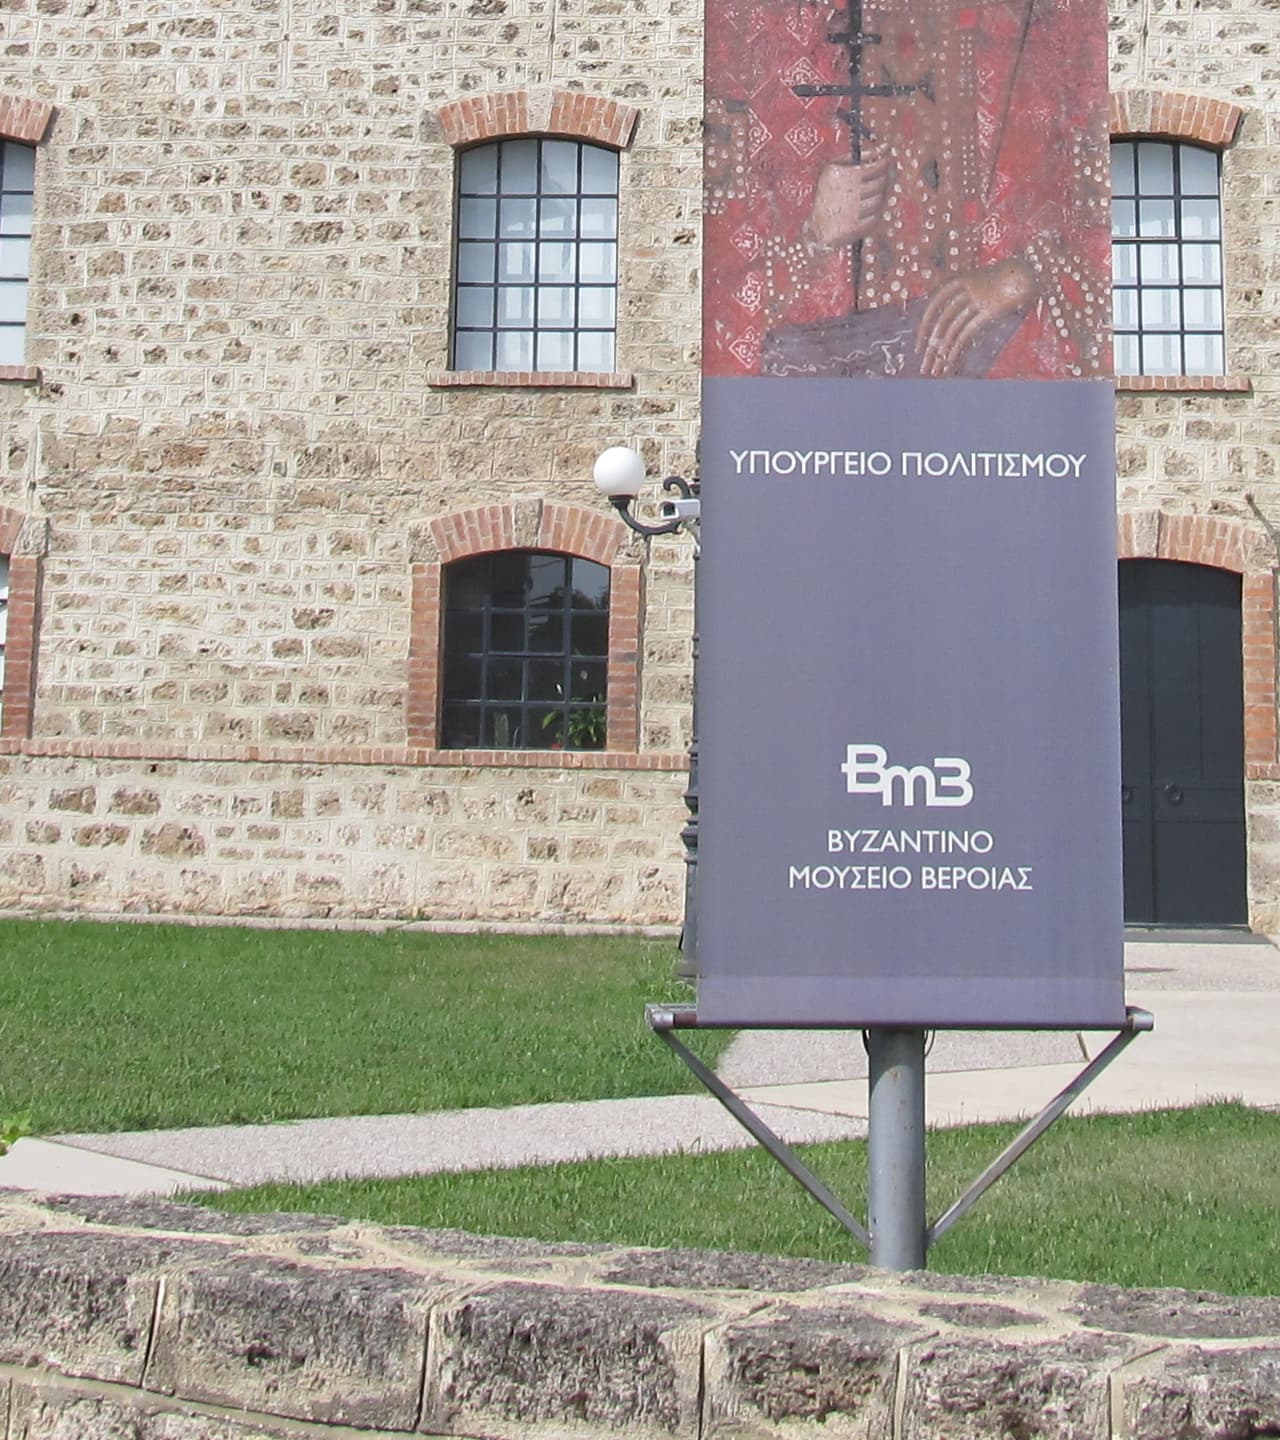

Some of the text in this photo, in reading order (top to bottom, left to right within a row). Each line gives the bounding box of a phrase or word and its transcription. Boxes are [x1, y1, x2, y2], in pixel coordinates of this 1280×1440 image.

[729, 449, 1087, 478] ΥΠΟΥΡΓΕΙΟ ΠΟΛΙΤΙΣΜΟΥ
[828, 829, 994, 854] ΒΥΖΑΝΤΙΝΟ
[789, 865, 1033, 891] ΜΟΥΣΕΙΟ ΒΕΡΟΙΑΣ
